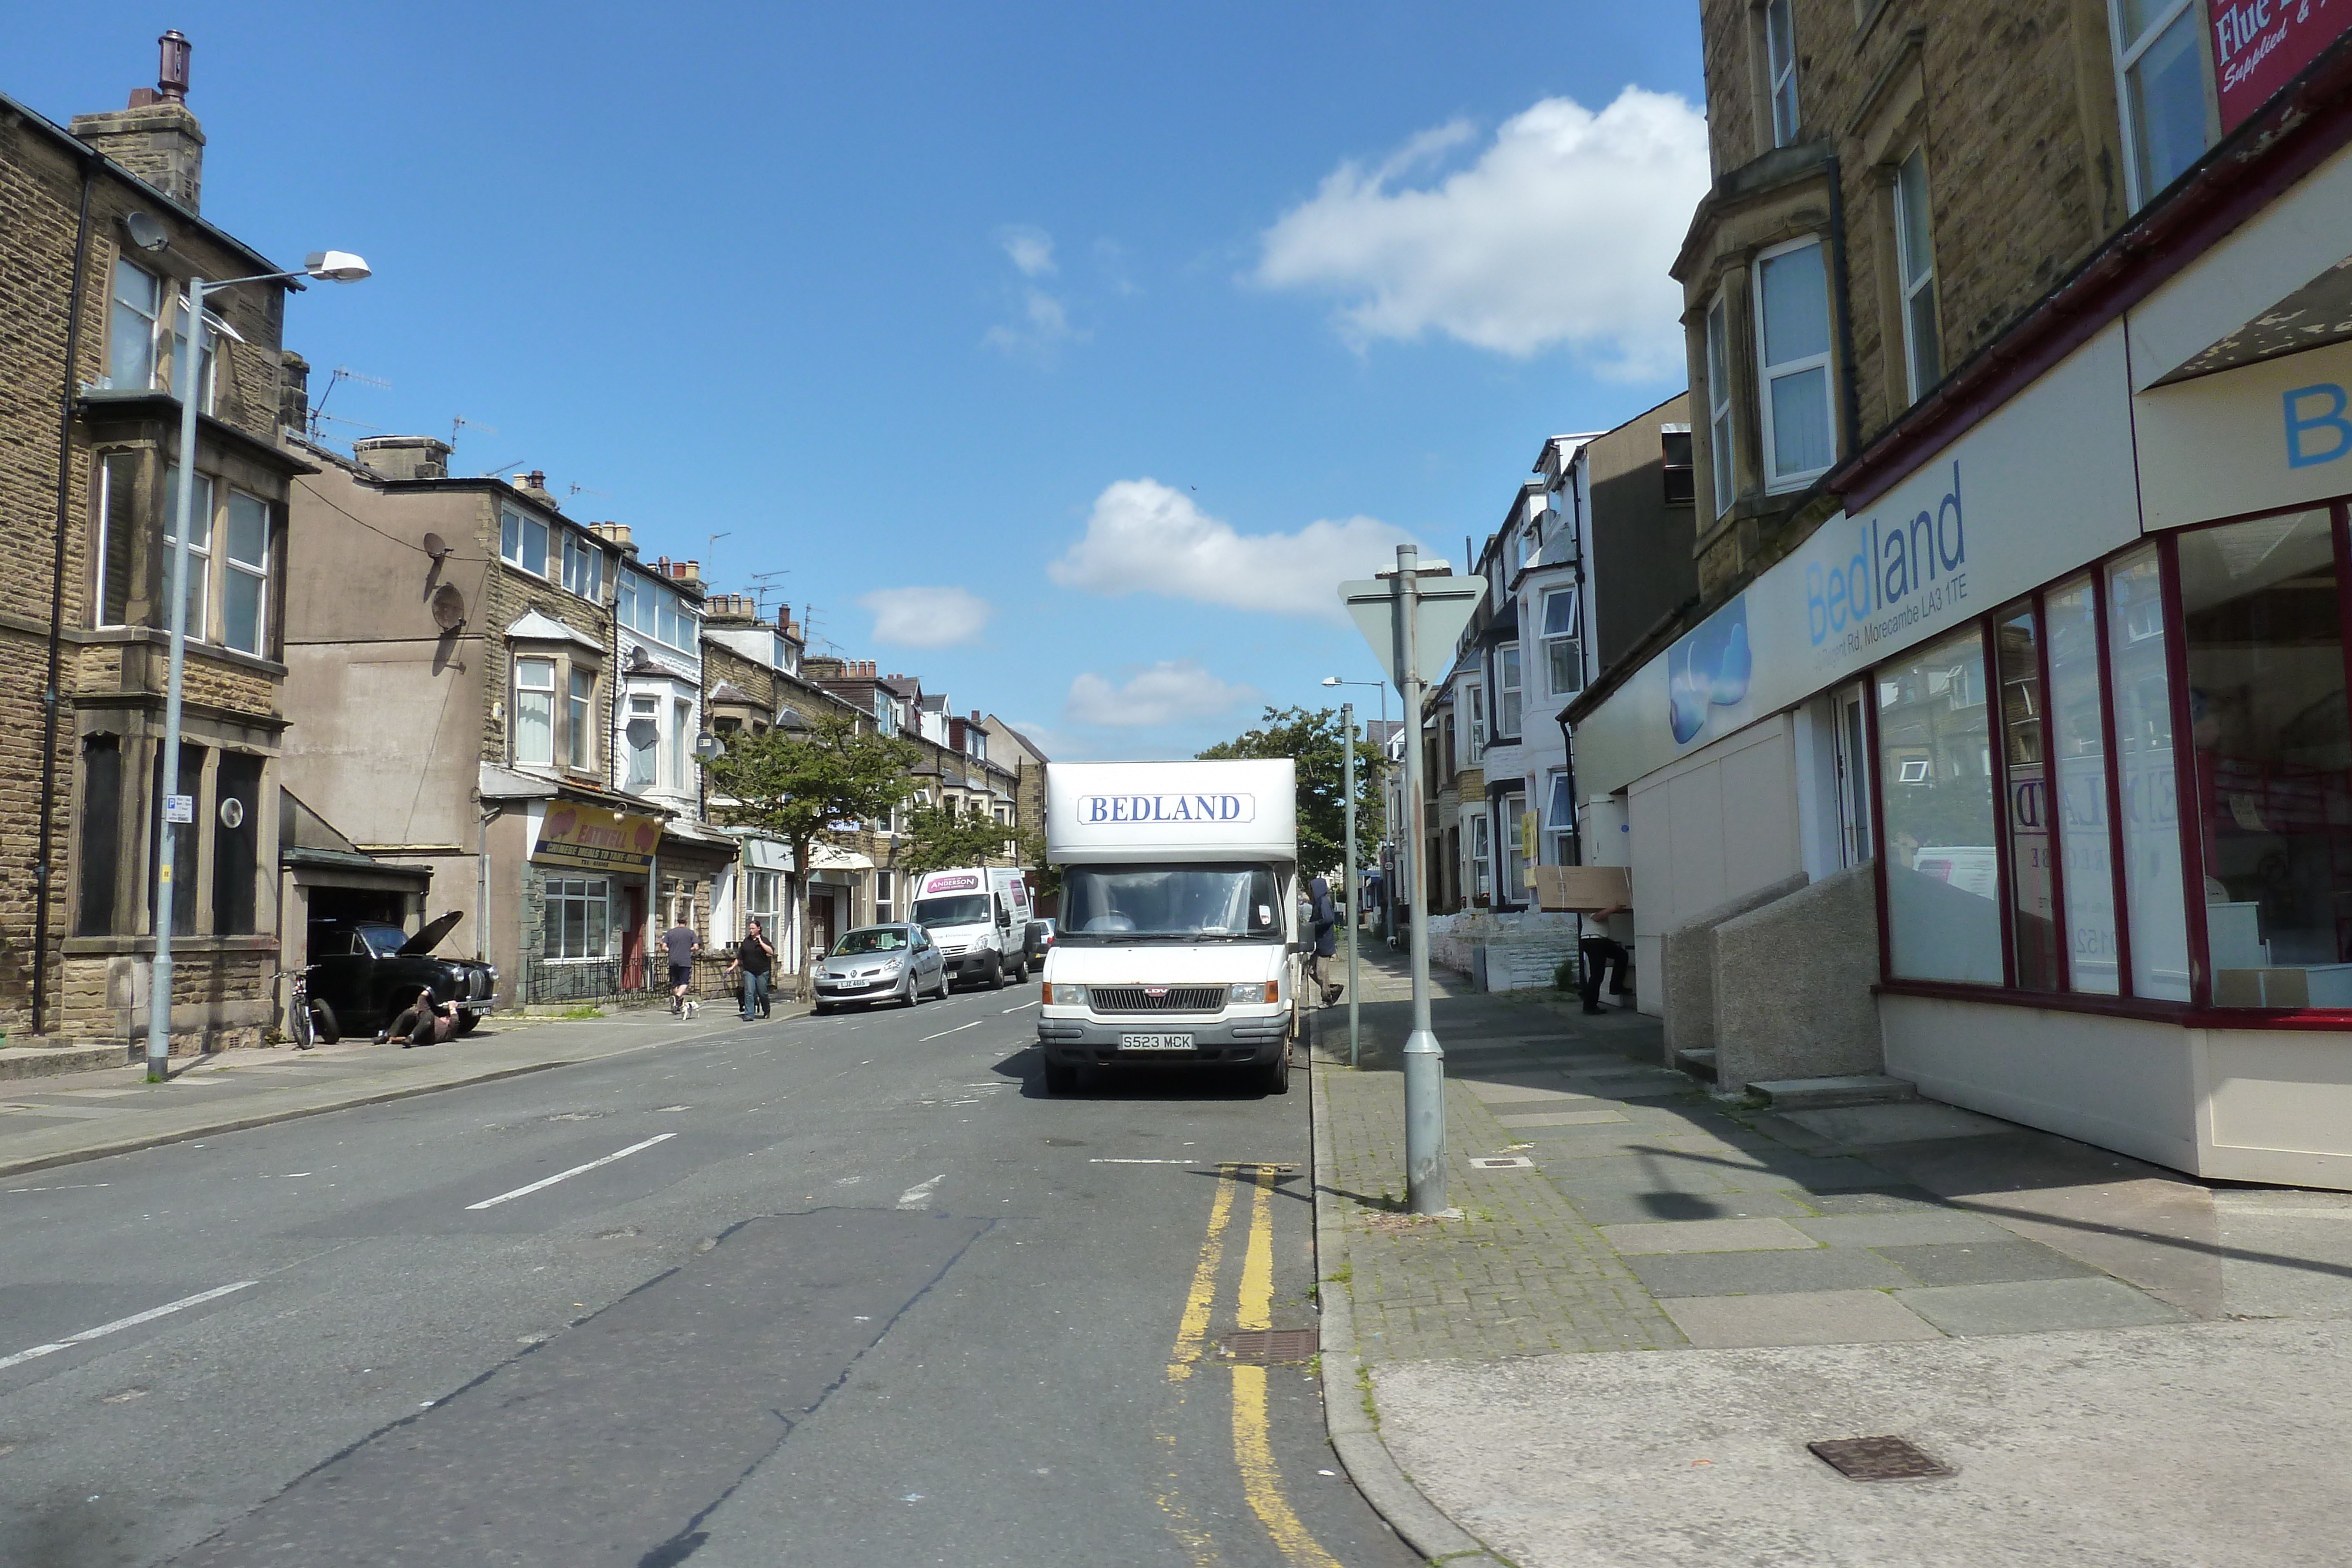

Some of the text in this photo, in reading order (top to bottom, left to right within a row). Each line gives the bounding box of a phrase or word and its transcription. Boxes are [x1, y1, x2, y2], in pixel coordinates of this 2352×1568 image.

[2216, 0, 2271, 66] Flue
[2223, 18, 2287, 92] Supplied
[1806, 459, 1965, 646] Bedland
[1864, 604, 1919, 646] Morecambe
[1922, 588, 1942, 618] LA3
[1946, 573, 1967, 605] 1TE
[1089, 795, 1240, 821] BEDLAND
[576, 824, 627, 848] EATWELL
[931, 878, 974, 889] ANDERSON
[1124, 1037, 1191, 1047] S523 MCK
